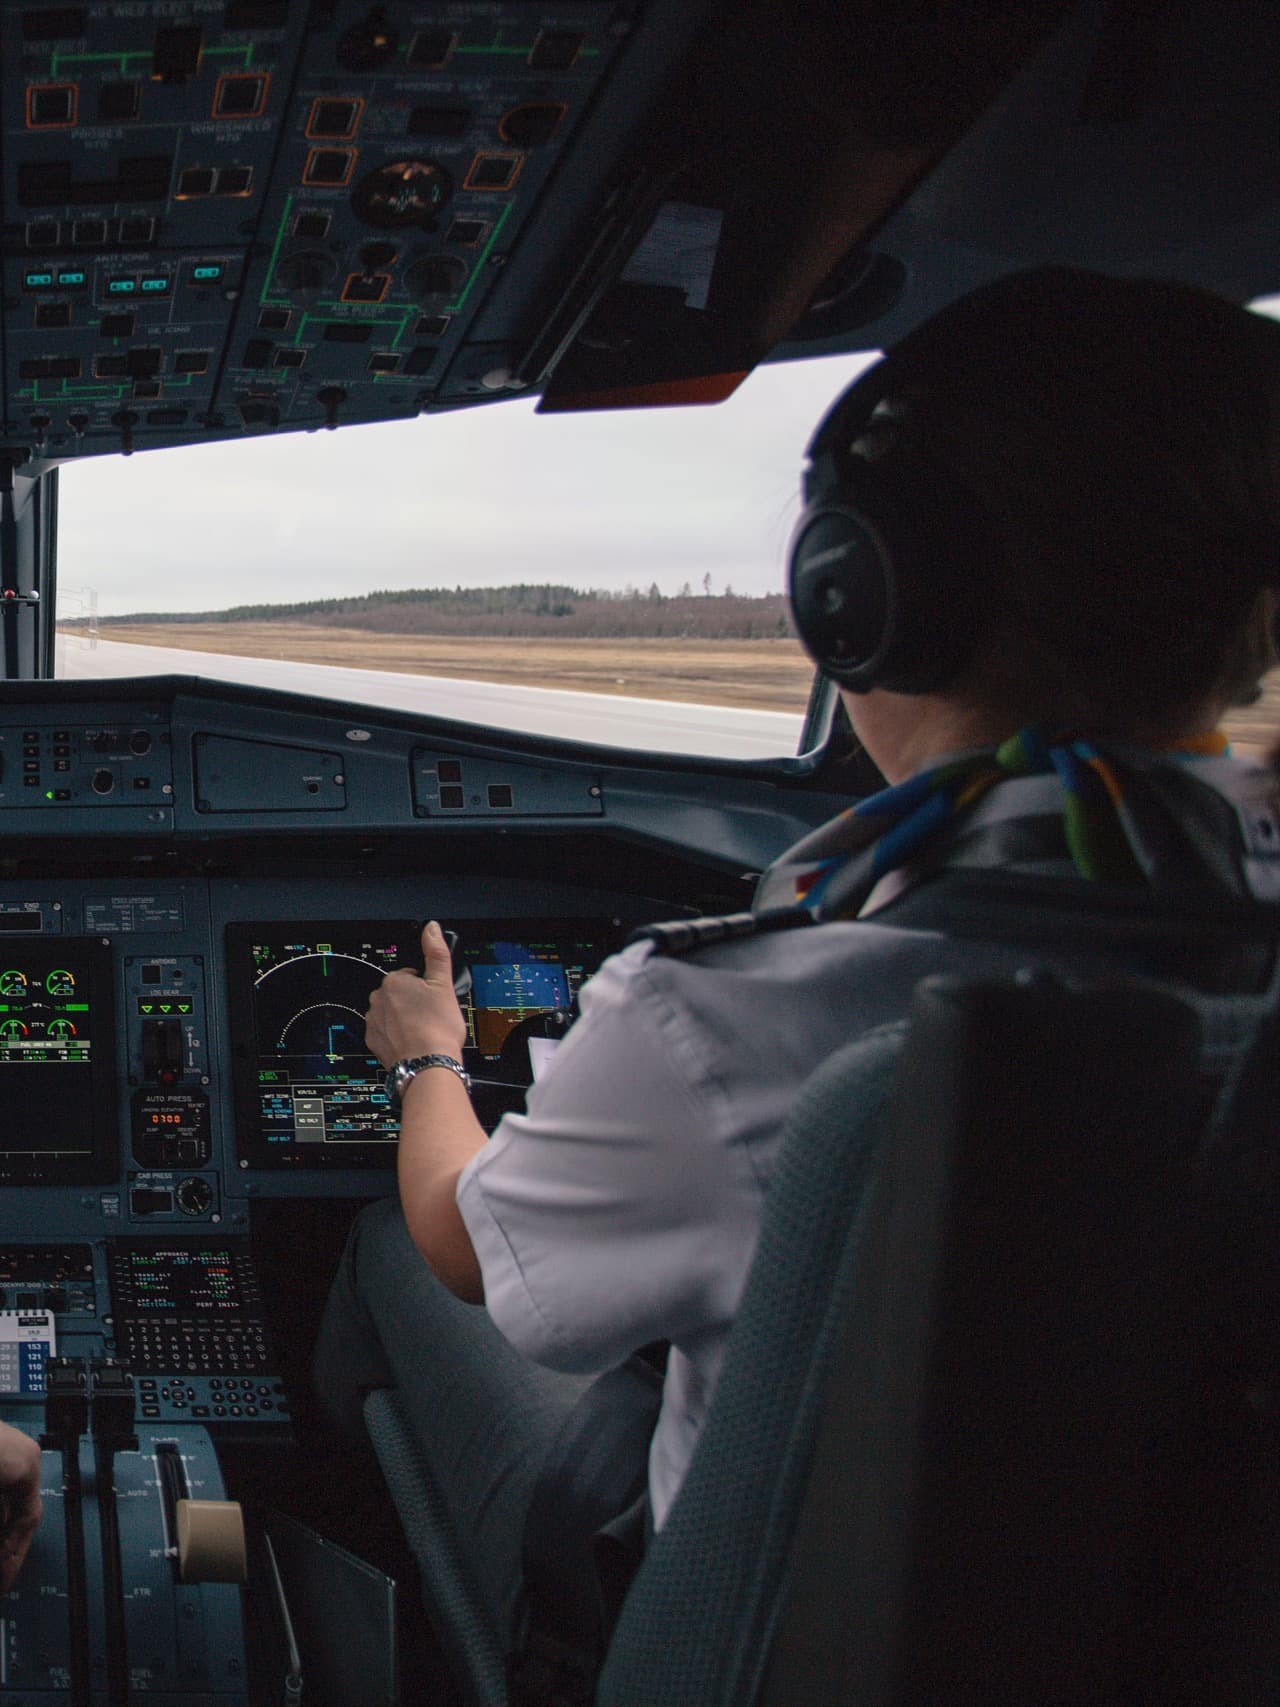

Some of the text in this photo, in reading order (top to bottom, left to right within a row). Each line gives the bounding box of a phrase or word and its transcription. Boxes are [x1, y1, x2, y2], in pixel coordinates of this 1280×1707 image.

[121, 253, 149, 261] ICING
[167, 1095, 192, 1103] PRESS
[127, 1489, 149, 1497] AUTO
